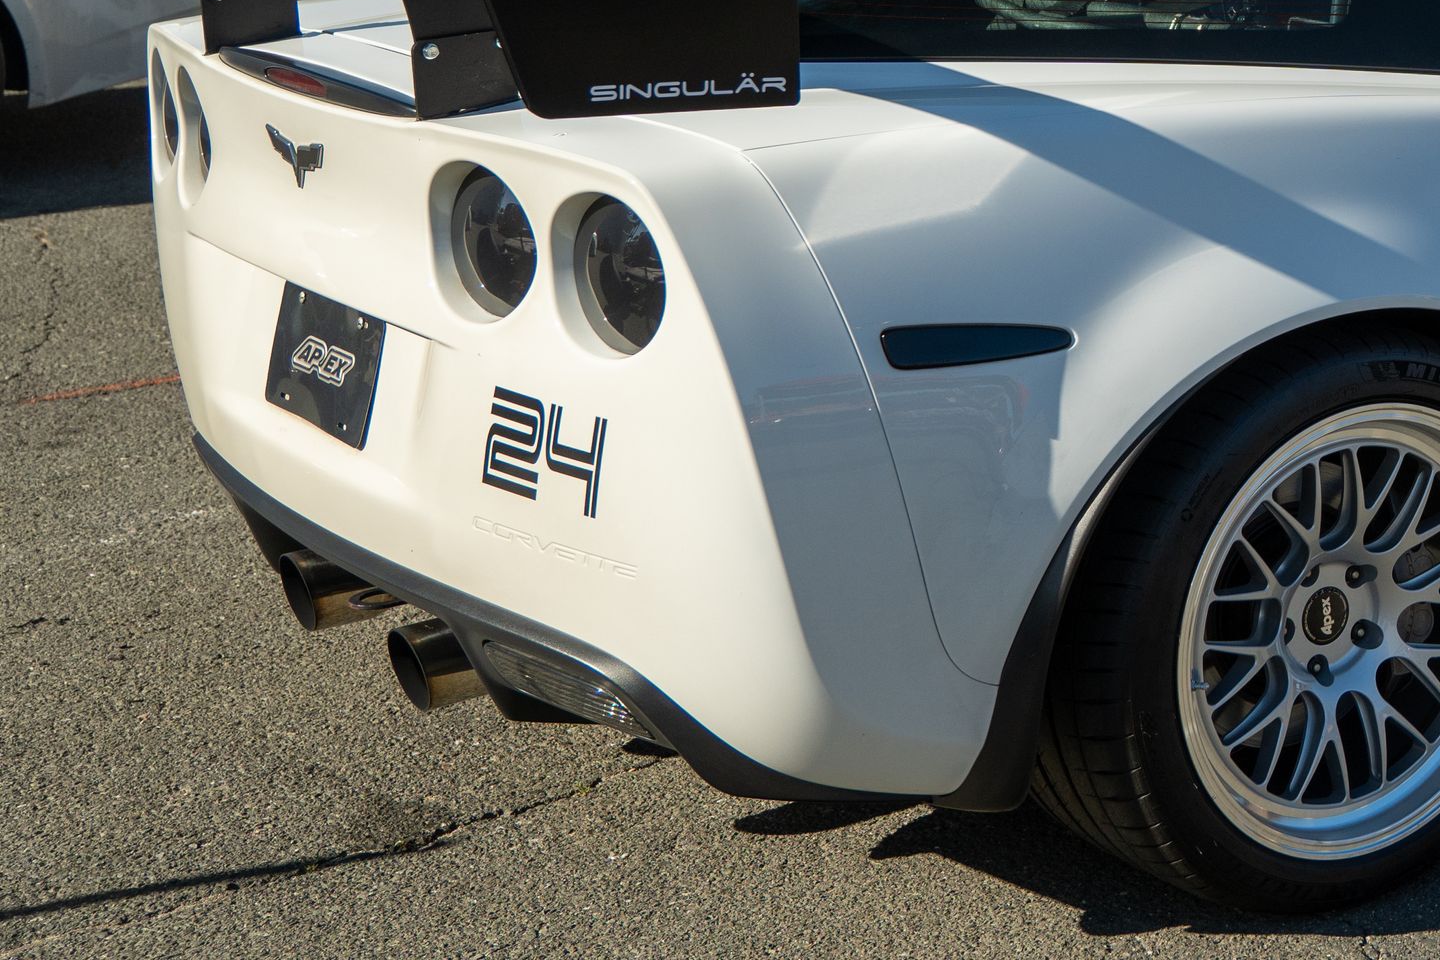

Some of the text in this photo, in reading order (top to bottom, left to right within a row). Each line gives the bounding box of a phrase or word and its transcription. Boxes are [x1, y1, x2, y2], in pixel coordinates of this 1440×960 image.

[589, 72, 787, 102] SINGULÄR
[294, 341, 353, 382] APEX
[482, 385, 608, 519] 24
[472, 515, 639, 580] CORVETTE
[1320, 596, 1335, 635] Apex
